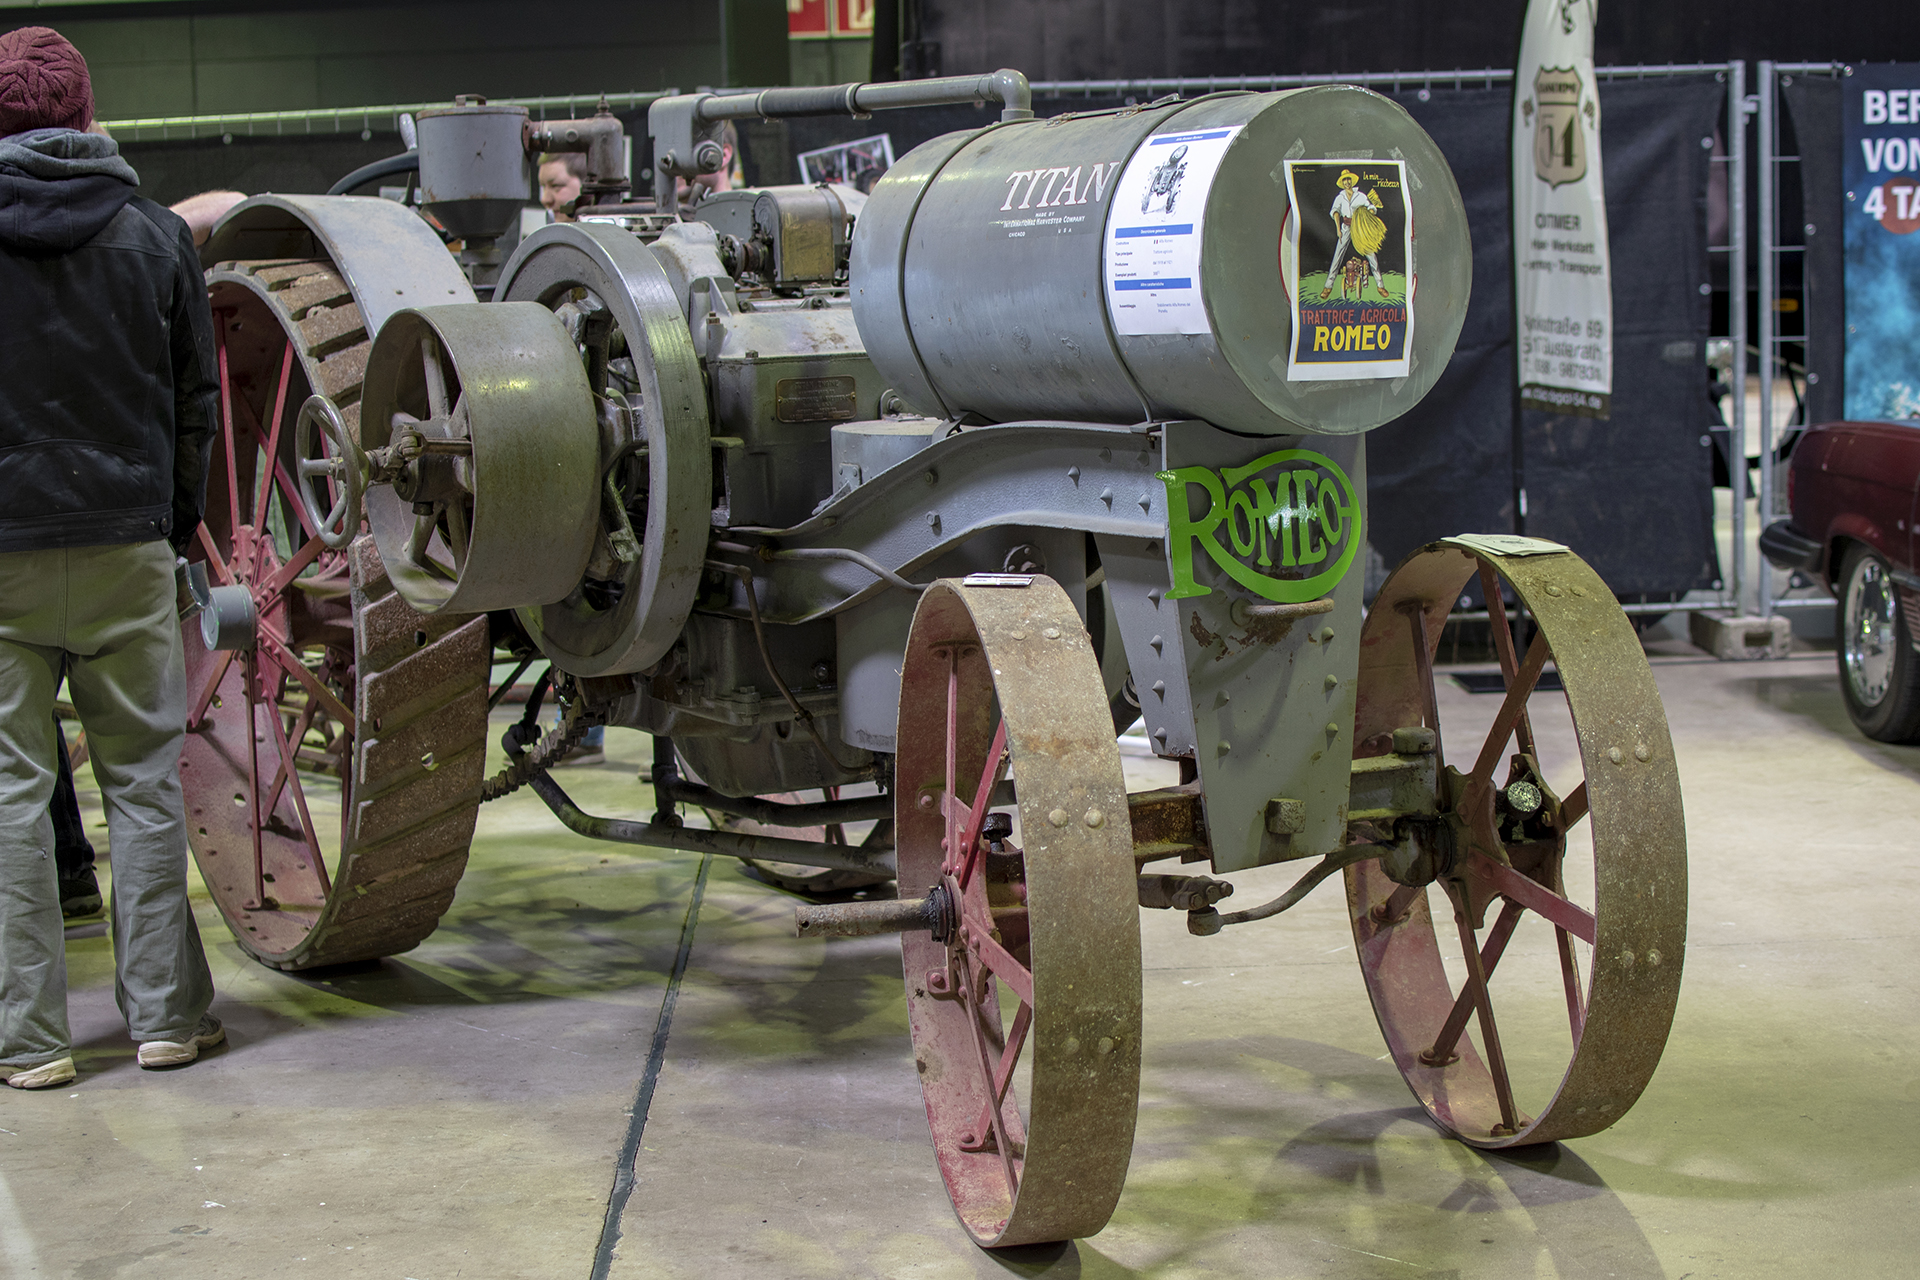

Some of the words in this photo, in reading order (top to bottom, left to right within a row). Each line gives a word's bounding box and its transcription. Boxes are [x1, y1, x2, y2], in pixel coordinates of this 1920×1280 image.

[1000, 161, 1120, 211] TITAN
[1862, 185, 1887, 221] 4
[1300, 309, 1355, 325] TRATTRICE
[1360, 308, 1406, 323] AGRICOLA
[1313, 324, 1391, 352] ROMEO
[1155, 449, 1362, 604] ROMEO
